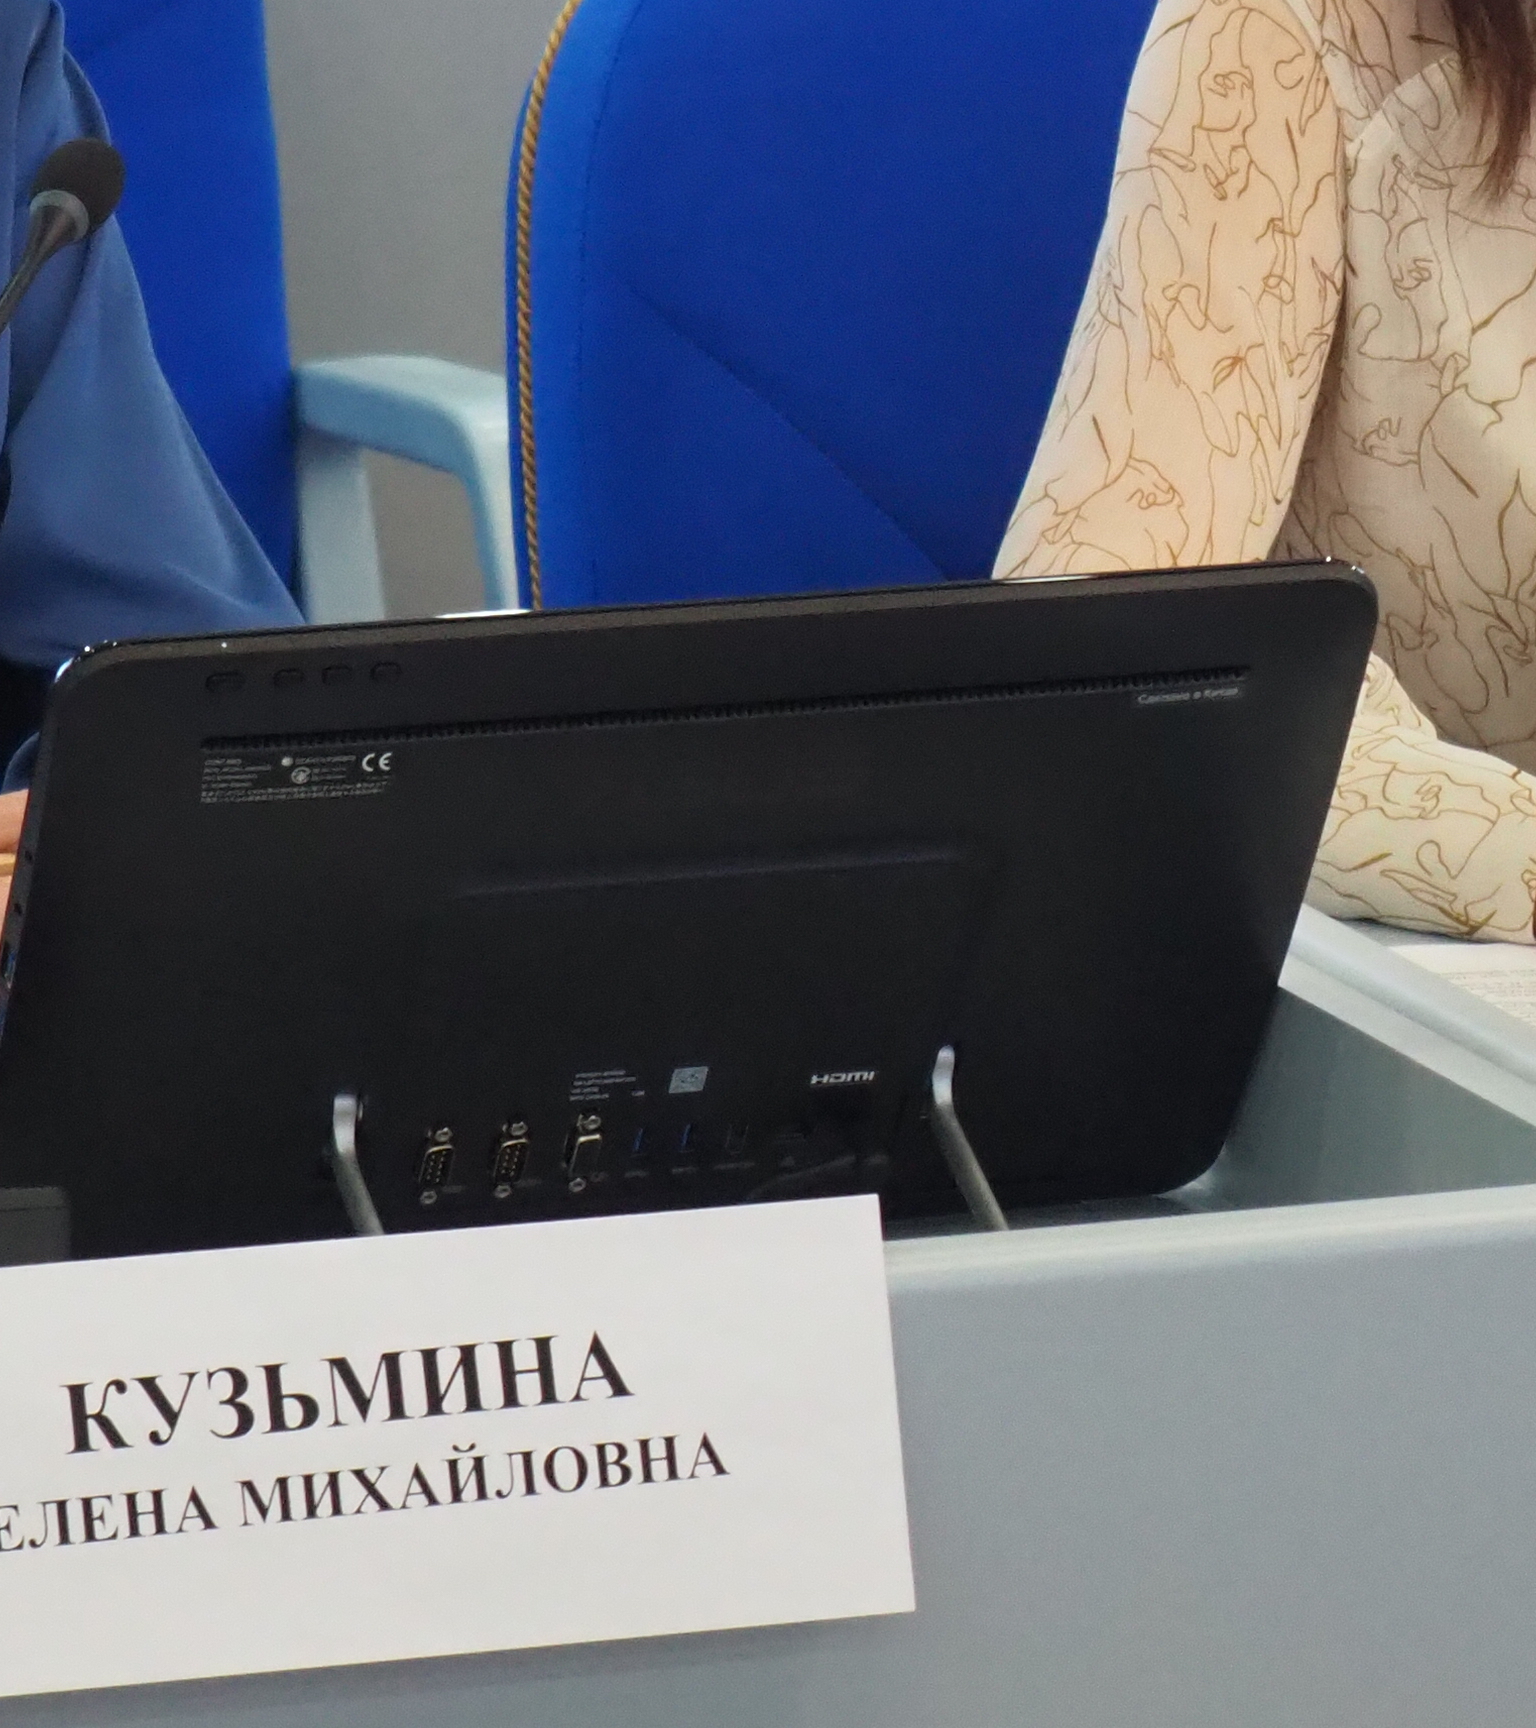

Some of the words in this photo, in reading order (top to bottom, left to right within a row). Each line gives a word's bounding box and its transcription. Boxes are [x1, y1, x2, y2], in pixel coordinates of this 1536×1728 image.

[809, 1070, 876, 1085] HDMI
[62, 1331, 635, 1455] КУЗЬМИНА
[238, 1432, 731, 1524] МИХАЙЛОВНА
